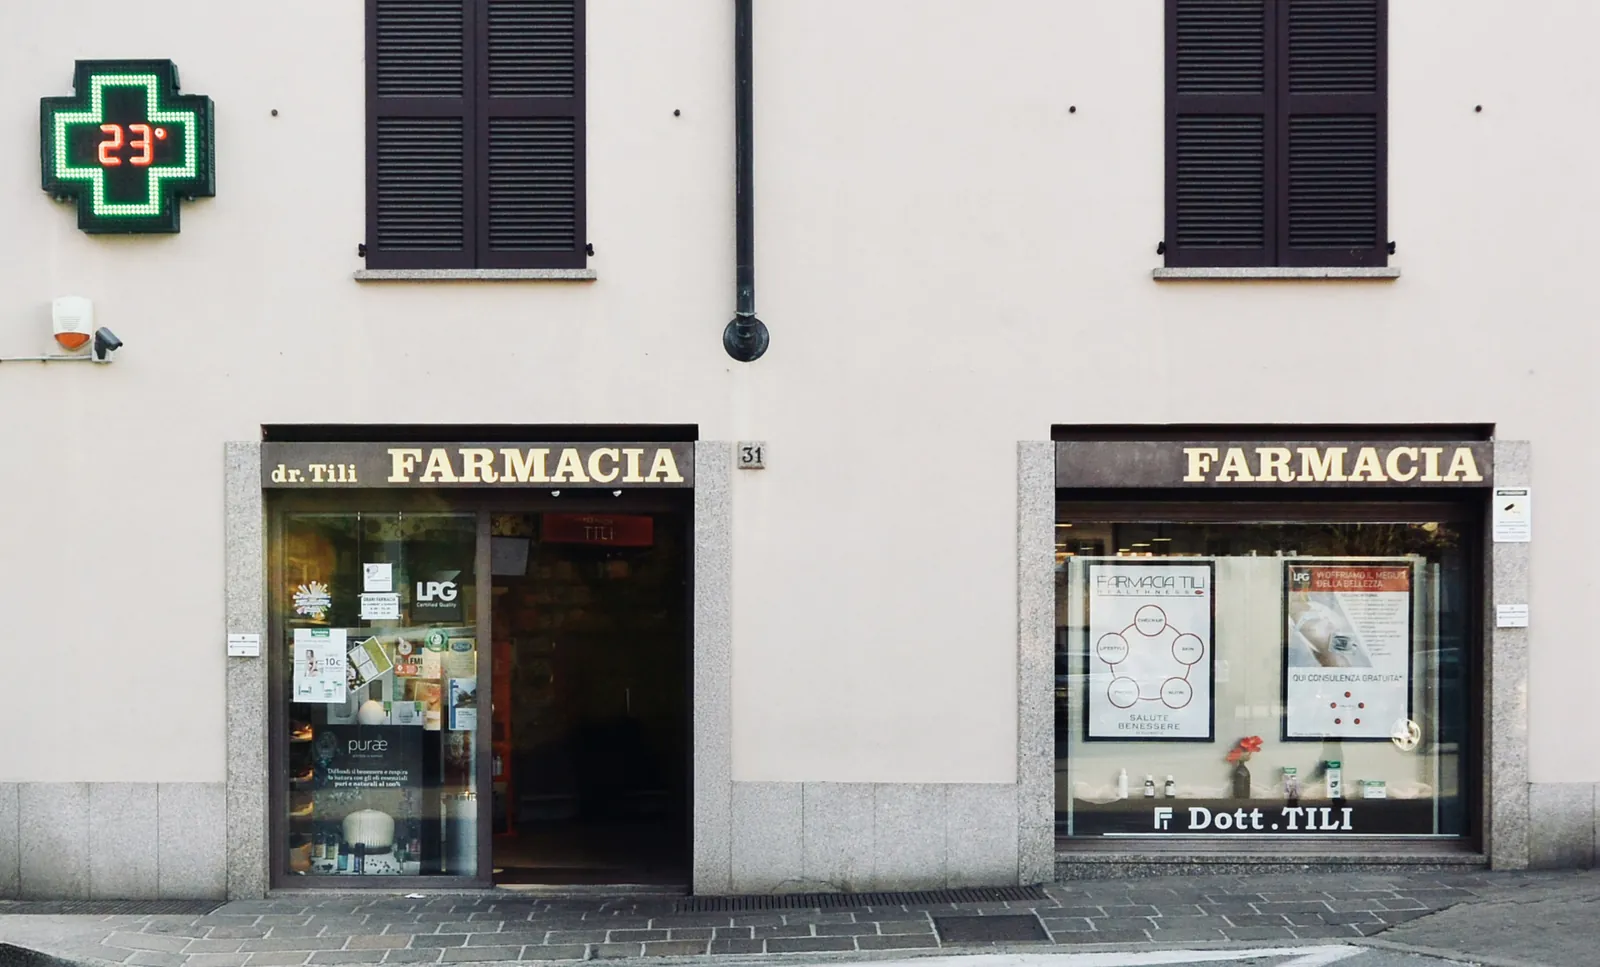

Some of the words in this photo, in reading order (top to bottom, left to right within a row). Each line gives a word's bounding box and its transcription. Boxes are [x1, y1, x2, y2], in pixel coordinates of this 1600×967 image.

[742, 446, 762, 463] 31
[271, 464, 305, 483] dr.
[308, 464, 358, 483] Tili
[387, 448, 684, 483] FARMACIA
[1183, 447, 1484, 482] FARMACIA
[1097, 575, 1175, 588] FARMACIA
[1179, 575, 1205, 589] TILI
[1316, 579, 1342, 587] DELLA
[1343, 579, 1384, 588] BELLEZZA
[416, 581, 458, 602] LPG
[439, 601, 457, 609] Quality
[1292, 673, 1307, 682] QUI
[1307, 674, 1361, 682] CONSULENZA
[1118, 722, 1181, 730] BENESSERE
